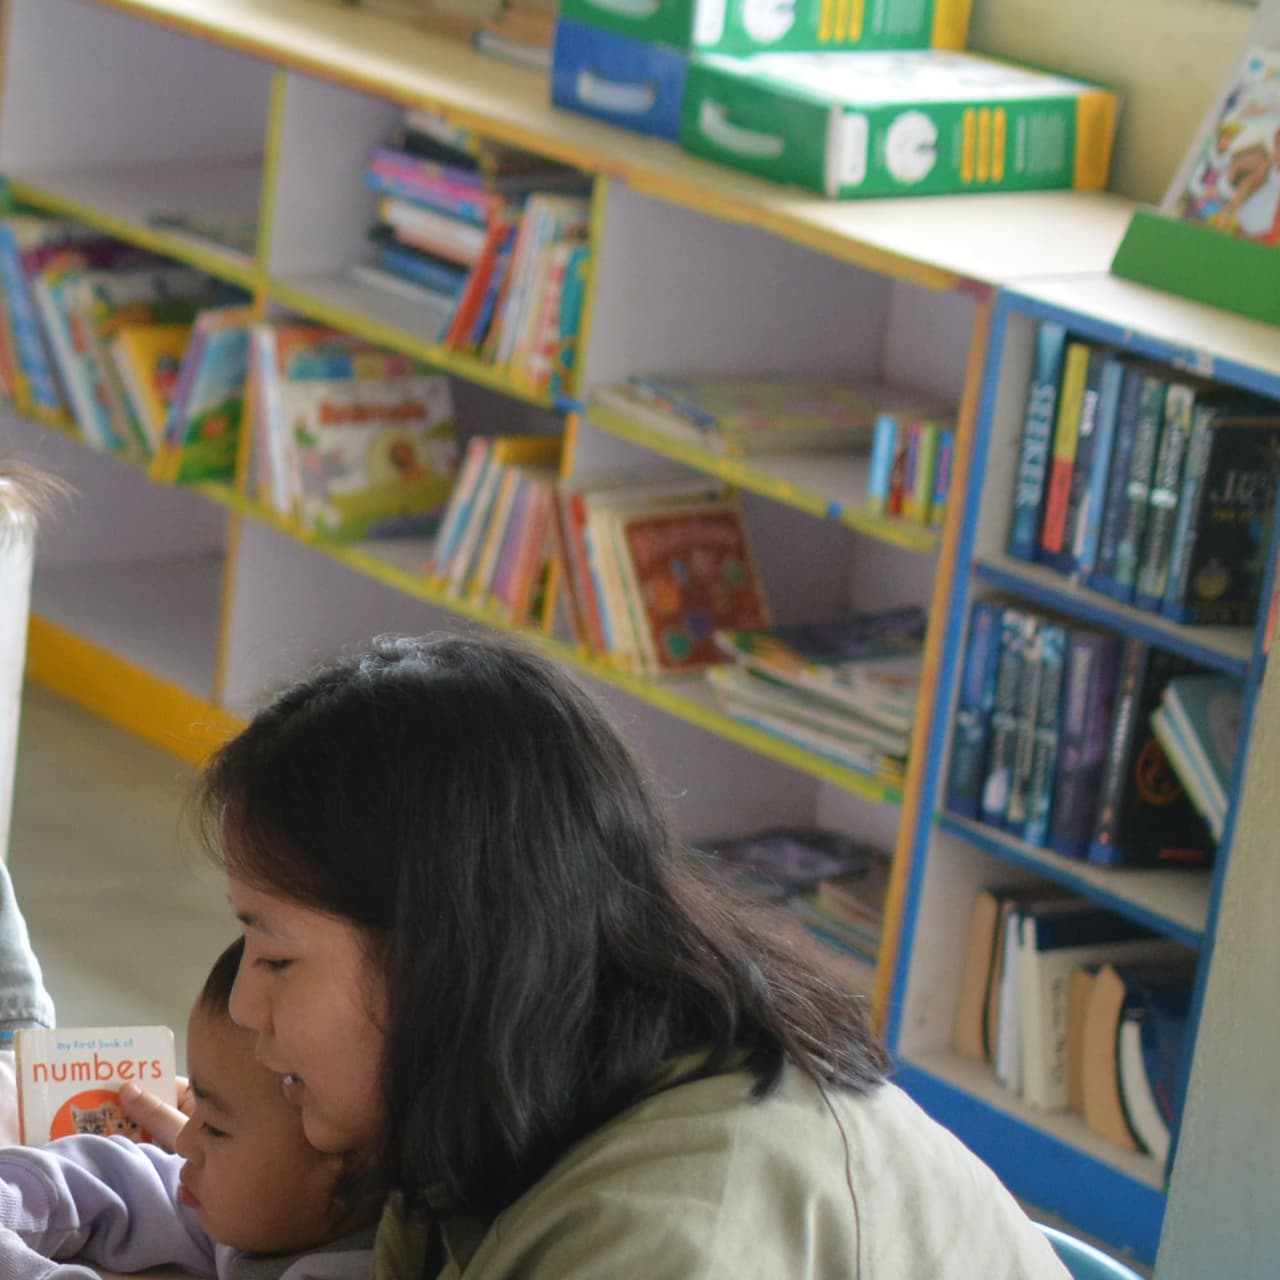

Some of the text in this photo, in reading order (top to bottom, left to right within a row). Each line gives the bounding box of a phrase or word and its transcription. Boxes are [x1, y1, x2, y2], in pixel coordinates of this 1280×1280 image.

[56, 1037, 134, 1052] my first book of
[32, 1052, 163, 1083] numbers
